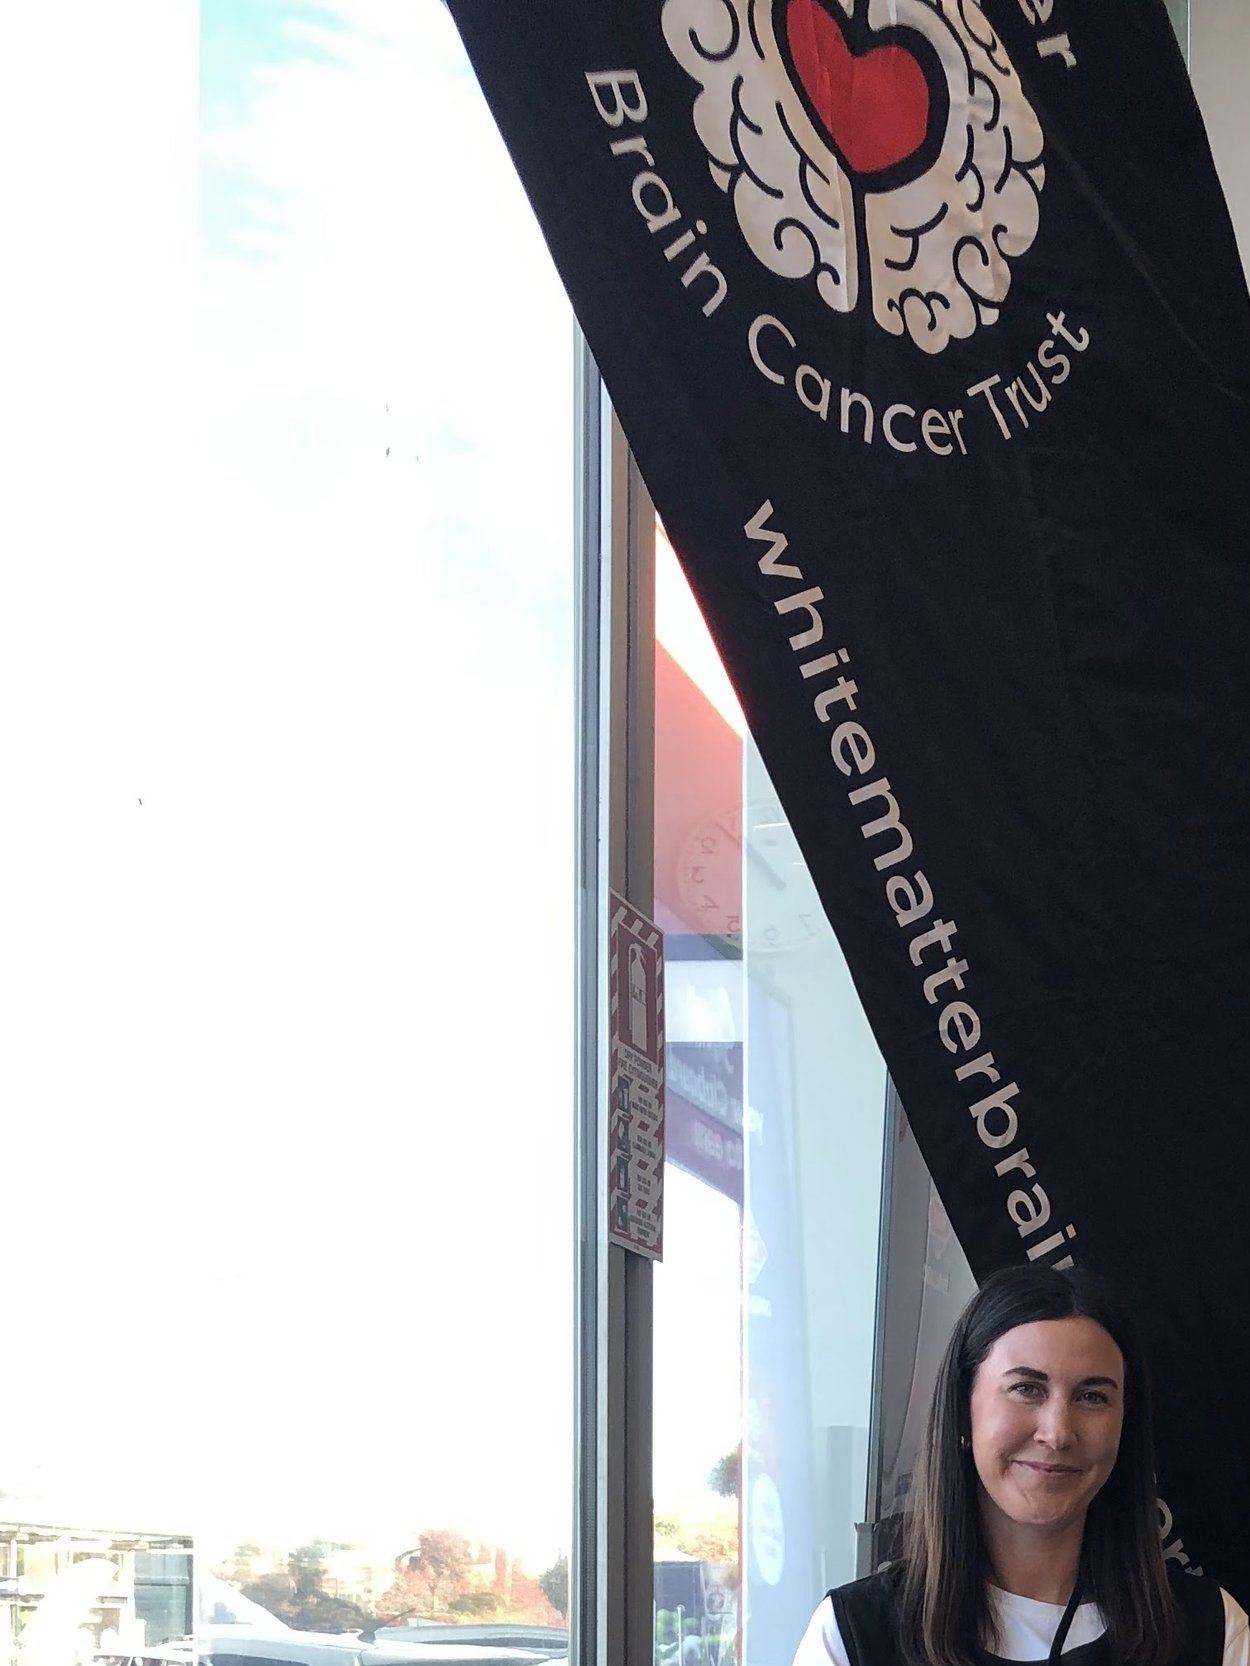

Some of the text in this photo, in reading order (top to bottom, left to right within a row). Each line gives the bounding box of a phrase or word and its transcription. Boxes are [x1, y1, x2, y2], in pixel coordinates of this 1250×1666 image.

[585, 69, 1091, 456] Brain Cancer Trust
